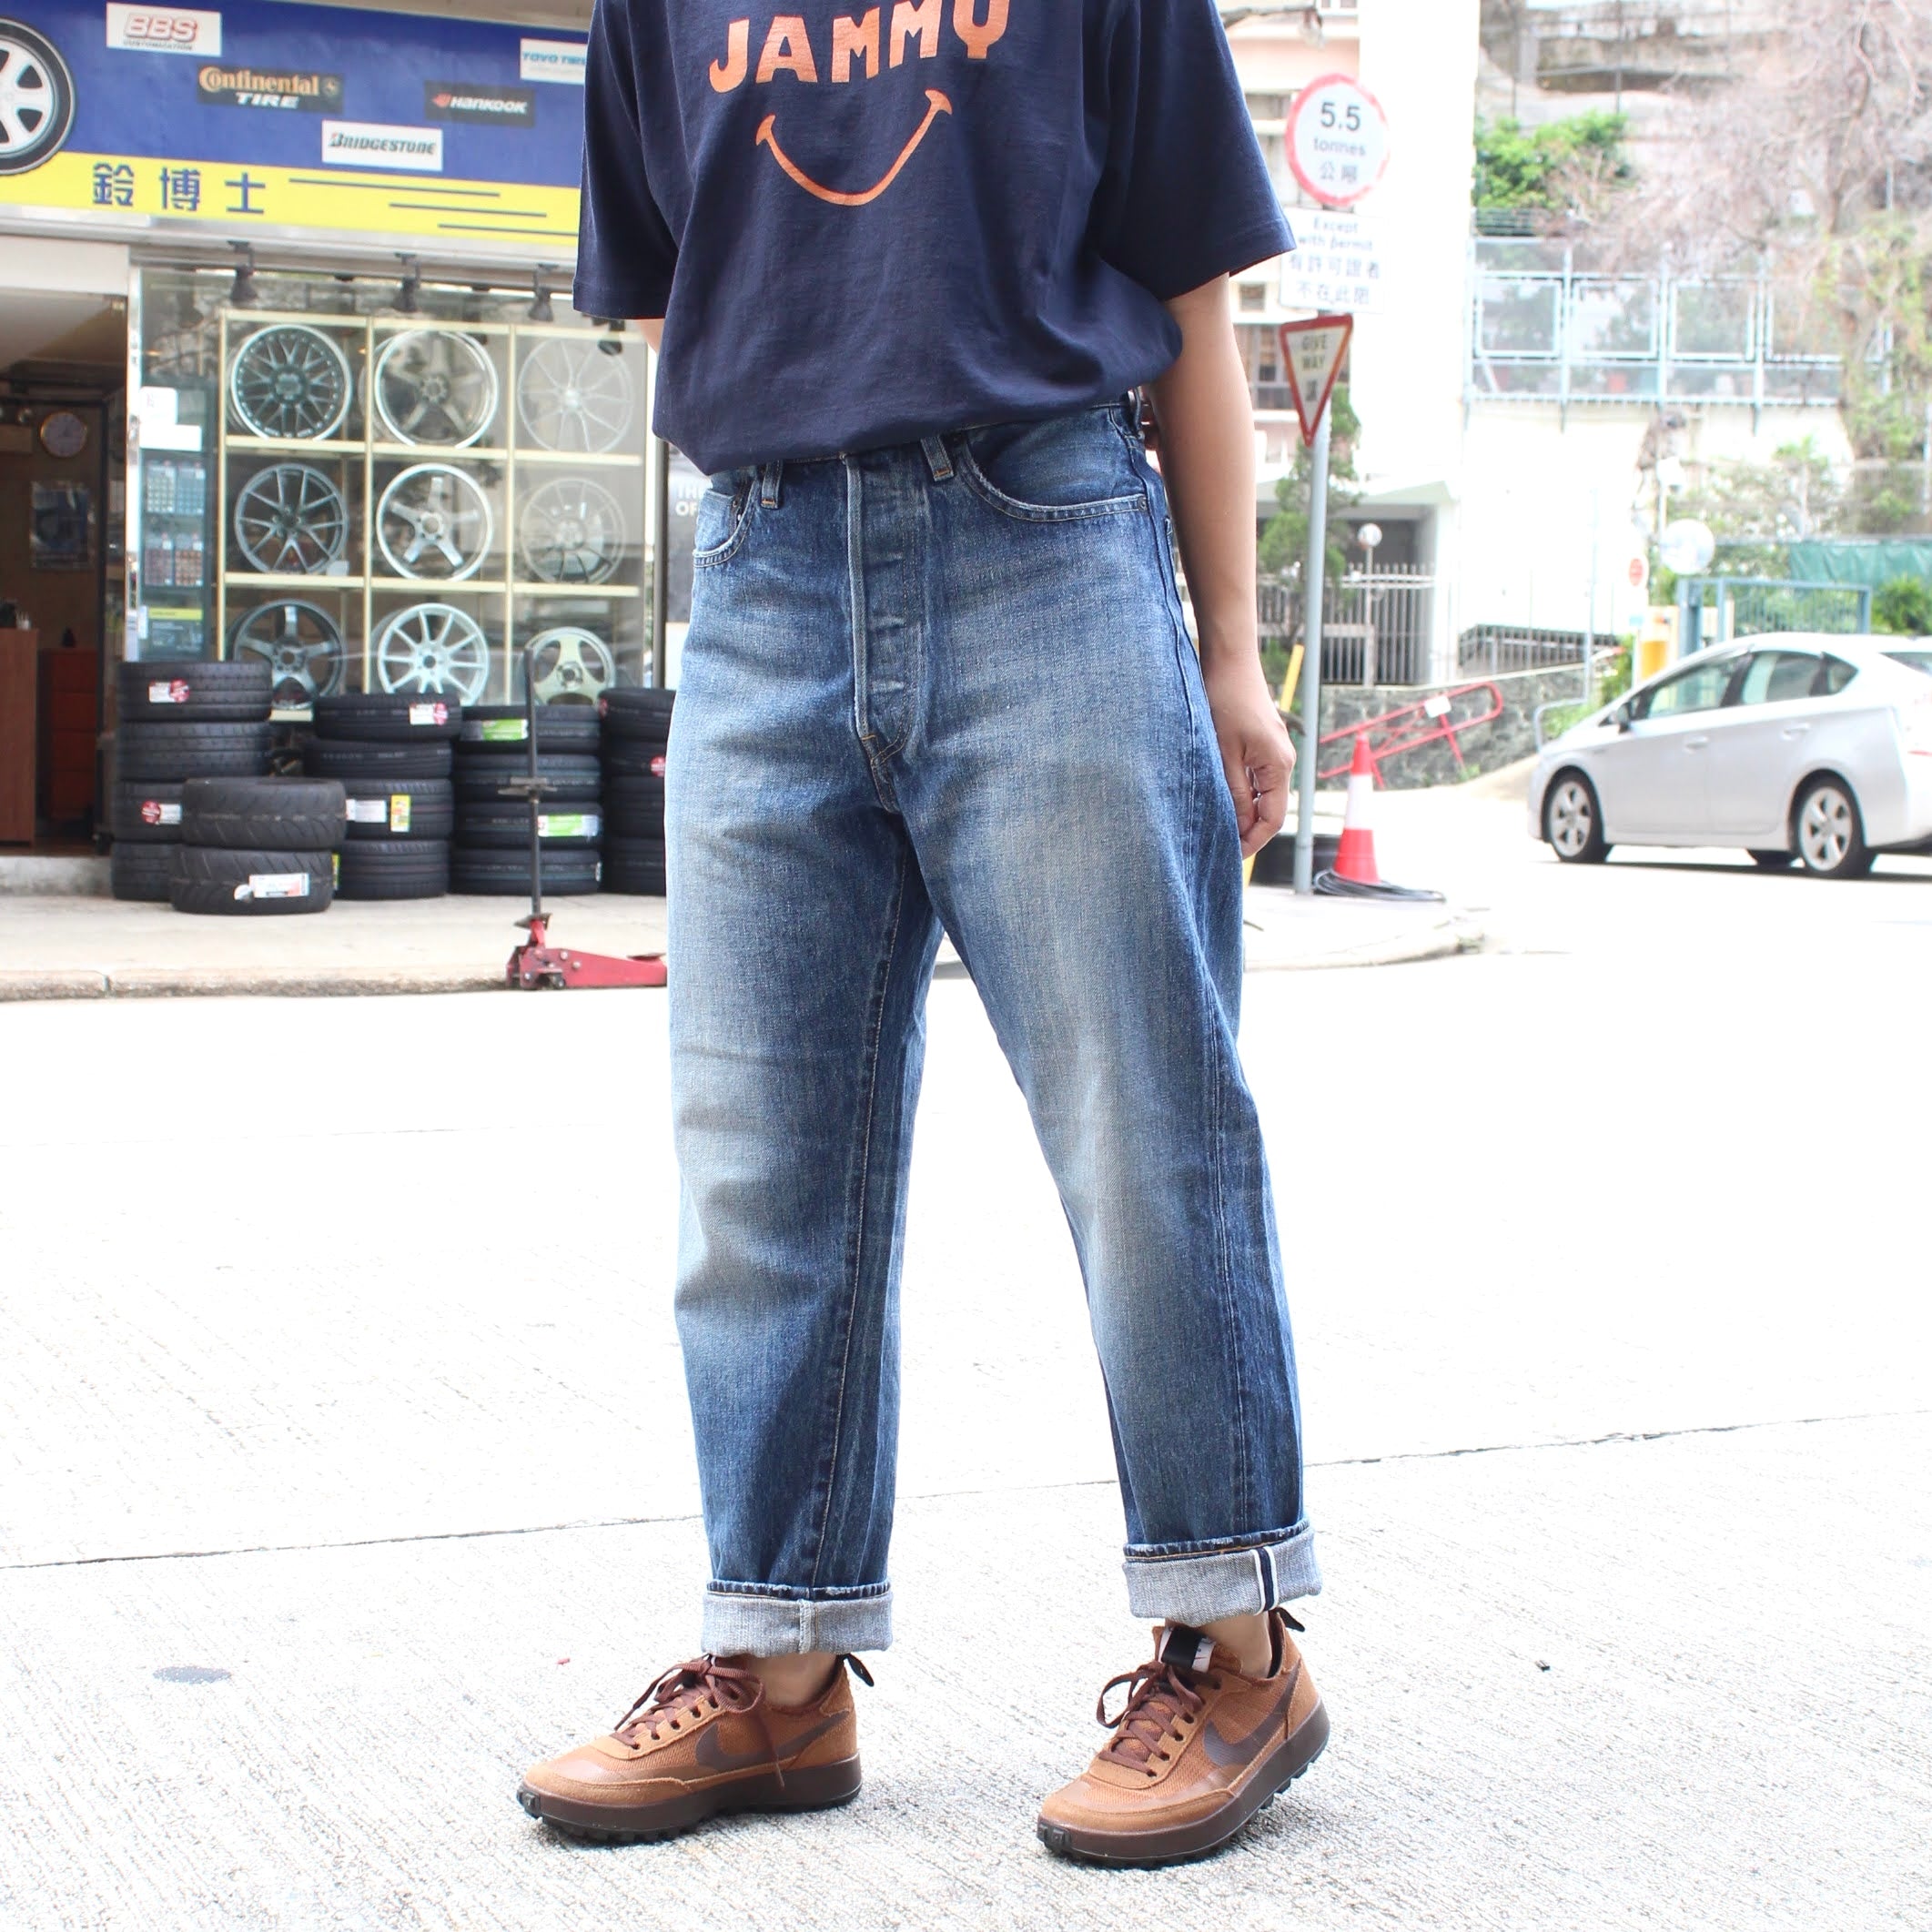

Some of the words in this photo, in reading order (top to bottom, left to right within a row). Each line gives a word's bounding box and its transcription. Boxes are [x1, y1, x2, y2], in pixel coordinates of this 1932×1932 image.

[124, 12, 197, 43] BBS
[198, 66, 319, 96] Continental
[235, 91, 300, 109] TIRE
[1320, 101, 1360, 131] 5.5
[329, 132, 437, 156] BRIDGESTONE
[1313, 137, 1366, 157] tonnes
[93, 162, 266, 215] 鈴博士
[1313, 215, 1359, 234] Except
[1298, 232, 1326, 247] with
